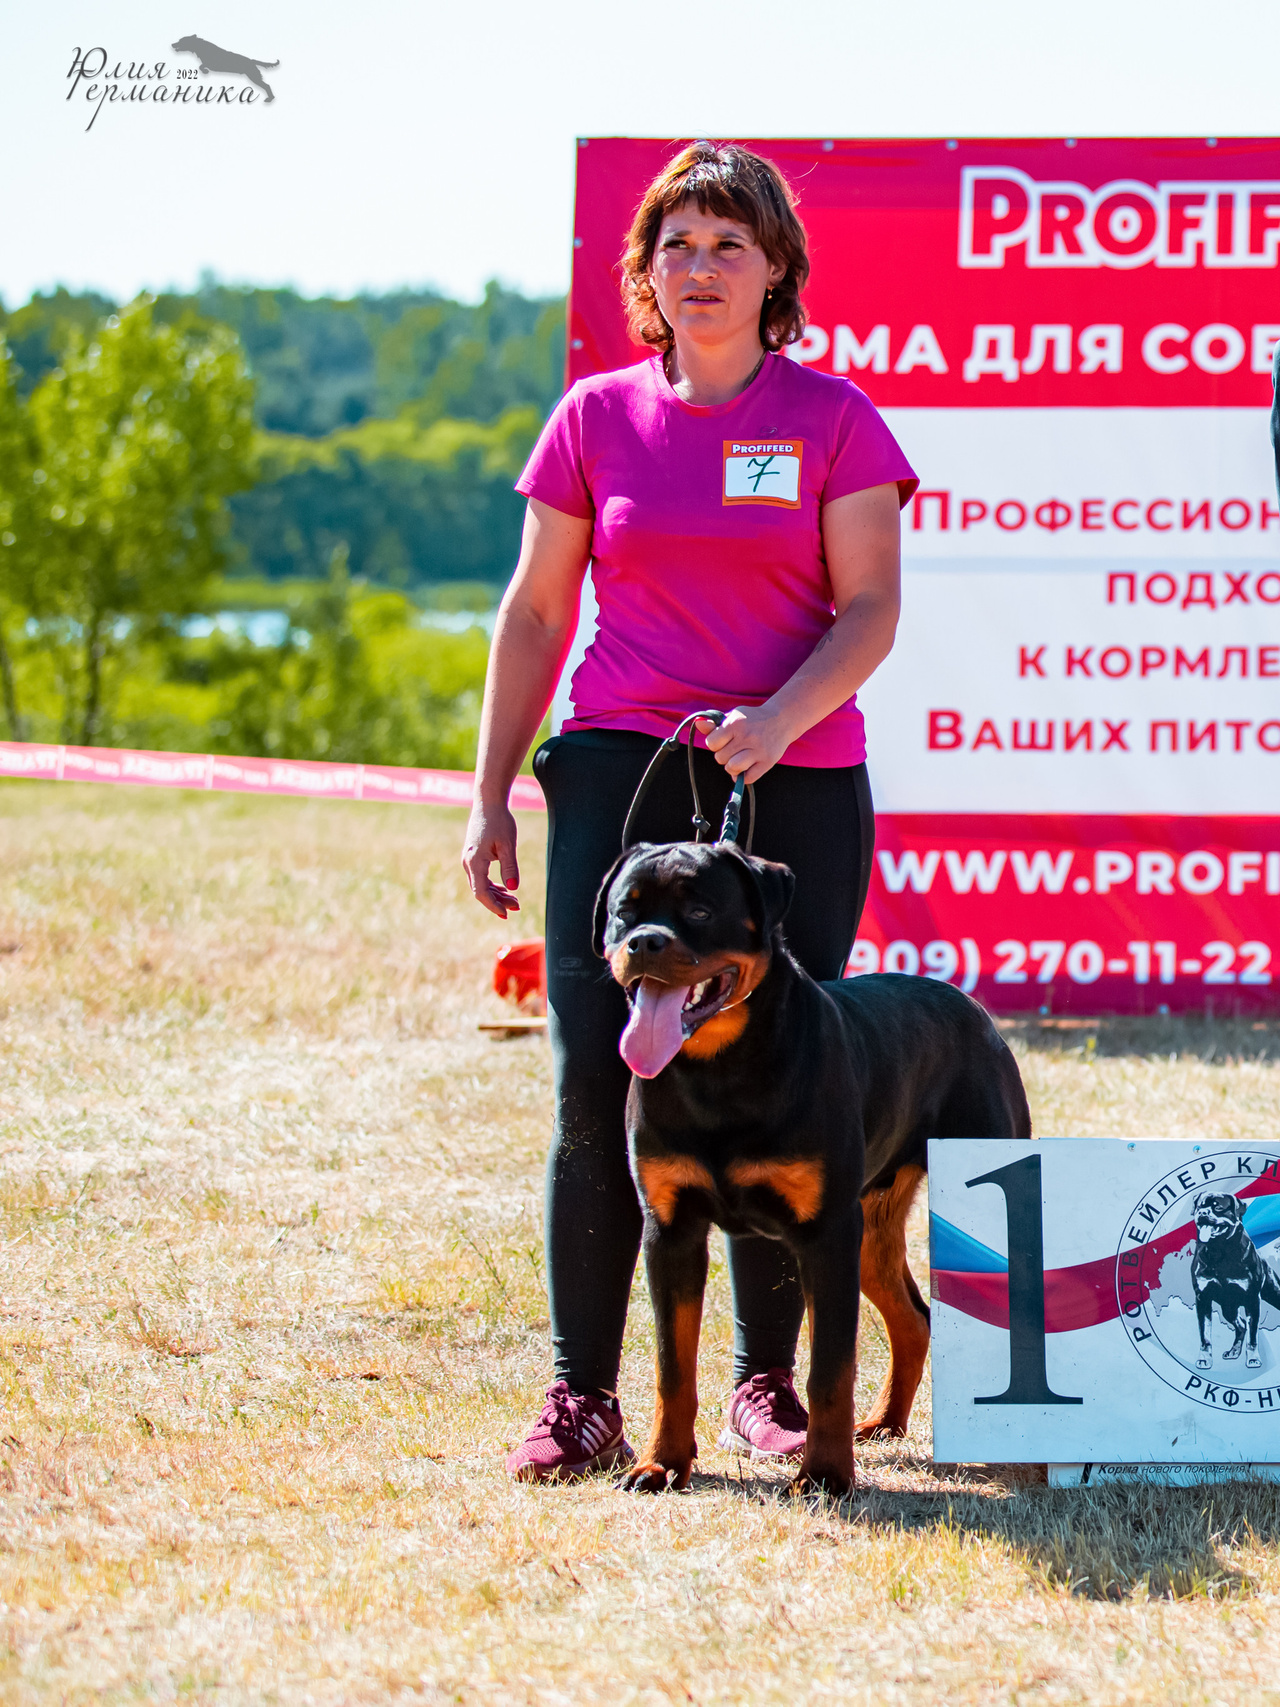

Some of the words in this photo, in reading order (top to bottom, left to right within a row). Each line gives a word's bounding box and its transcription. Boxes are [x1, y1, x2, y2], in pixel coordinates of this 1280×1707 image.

[963, 324, 1123, 383] ДЛЯ
[732, 444, 794, 454] PROFIFEED
[747, 455, 780, 493] 7
[1018, 645, 1047, 678] К
[926, 708, 1130, 752] ВАШИХ
[993, 940, 1272, 985] 270-11-22
[1121, 1160, 1217, 1343] РОТВЕЙЛЕР
[964, 1153, 1084, 1405] 1
[1098, 1464, 1139, 1476] Корма
[1141, 1465, 1182, 1474] нового
